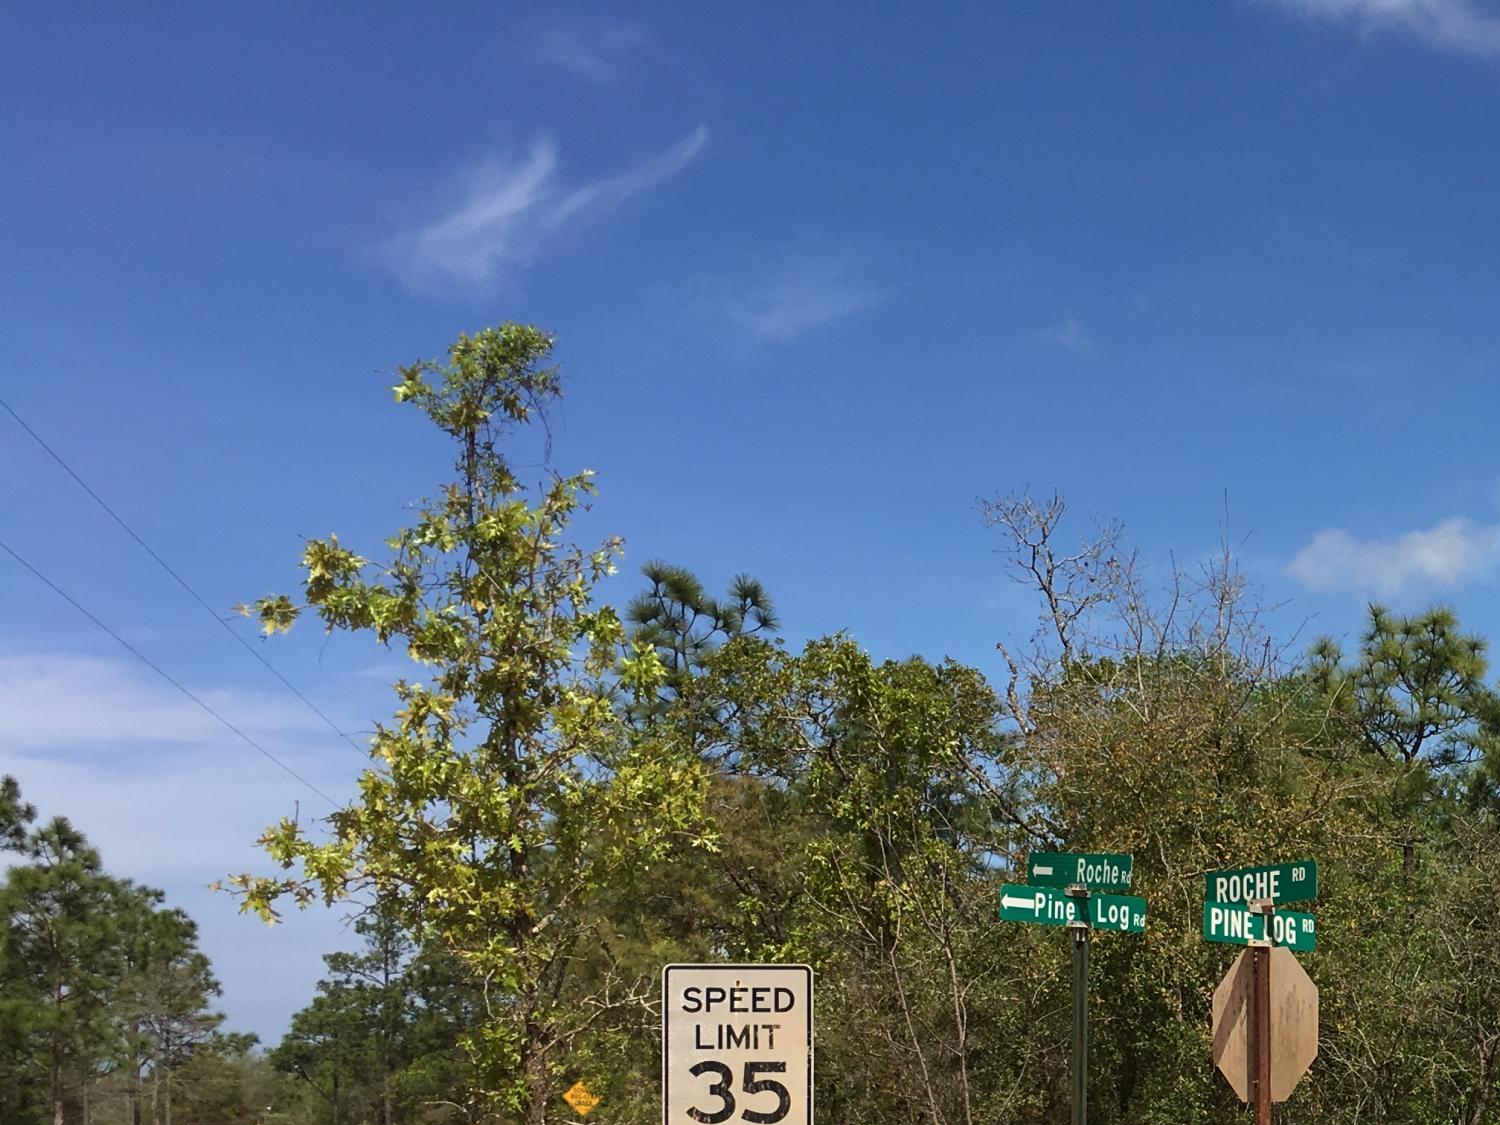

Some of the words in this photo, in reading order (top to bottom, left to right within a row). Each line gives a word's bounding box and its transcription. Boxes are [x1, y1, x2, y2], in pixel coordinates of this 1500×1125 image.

[1076, 858, 1119, 884] Roche
[1120, 870, 1132, 884] Rd
[1216, 870, 1281, 903] ROCHE
[1292, 867, 1306, 882] RD
[1034, 892, 1075, 921] Pine
[1097, 898, 1130, 931] Log
[1133, 913, 1146, 927] Rd
[1210, 907, 1254, 939] PINE
[1302, 918, 1315, 933] RD
[681, 987, 795, 1013] SPEED
[695, 1024, 781, 1050] LIMIT
[686, 1060, 791, 1125] 35
